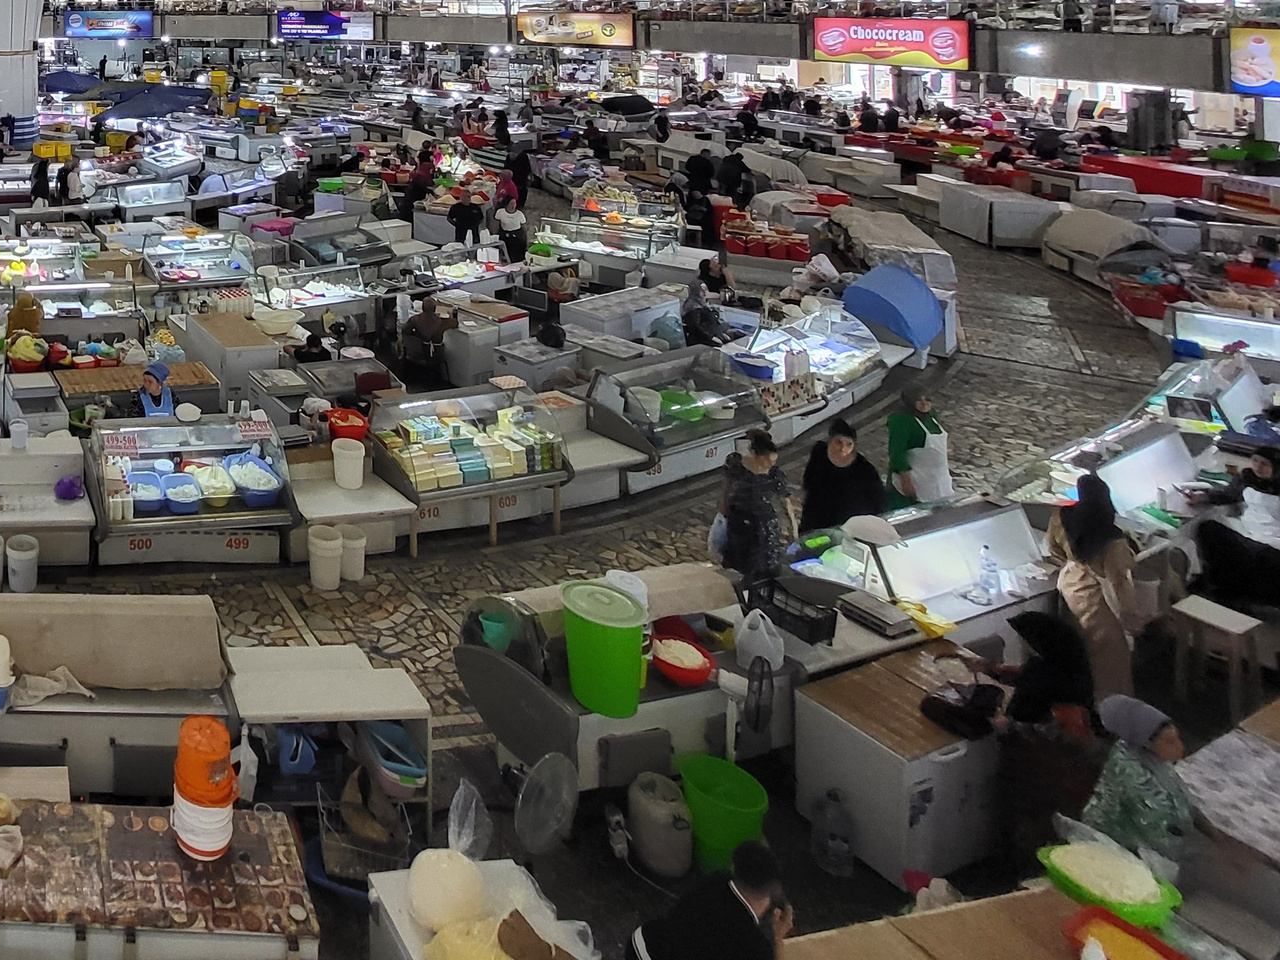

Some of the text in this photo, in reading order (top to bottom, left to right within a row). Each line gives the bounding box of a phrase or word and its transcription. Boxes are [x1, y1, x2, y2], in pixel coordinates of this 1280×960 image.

[850, 26, 924, 42] Chococream
[106, 435, 137, 445] 499-500
[705, 447, 718, 459] 497
[498, 495, 517, 508] 609
[419, 507, 439, 519] 610
[129, 538, 152, 550] 500
[225, 538, 250, 550] 499
